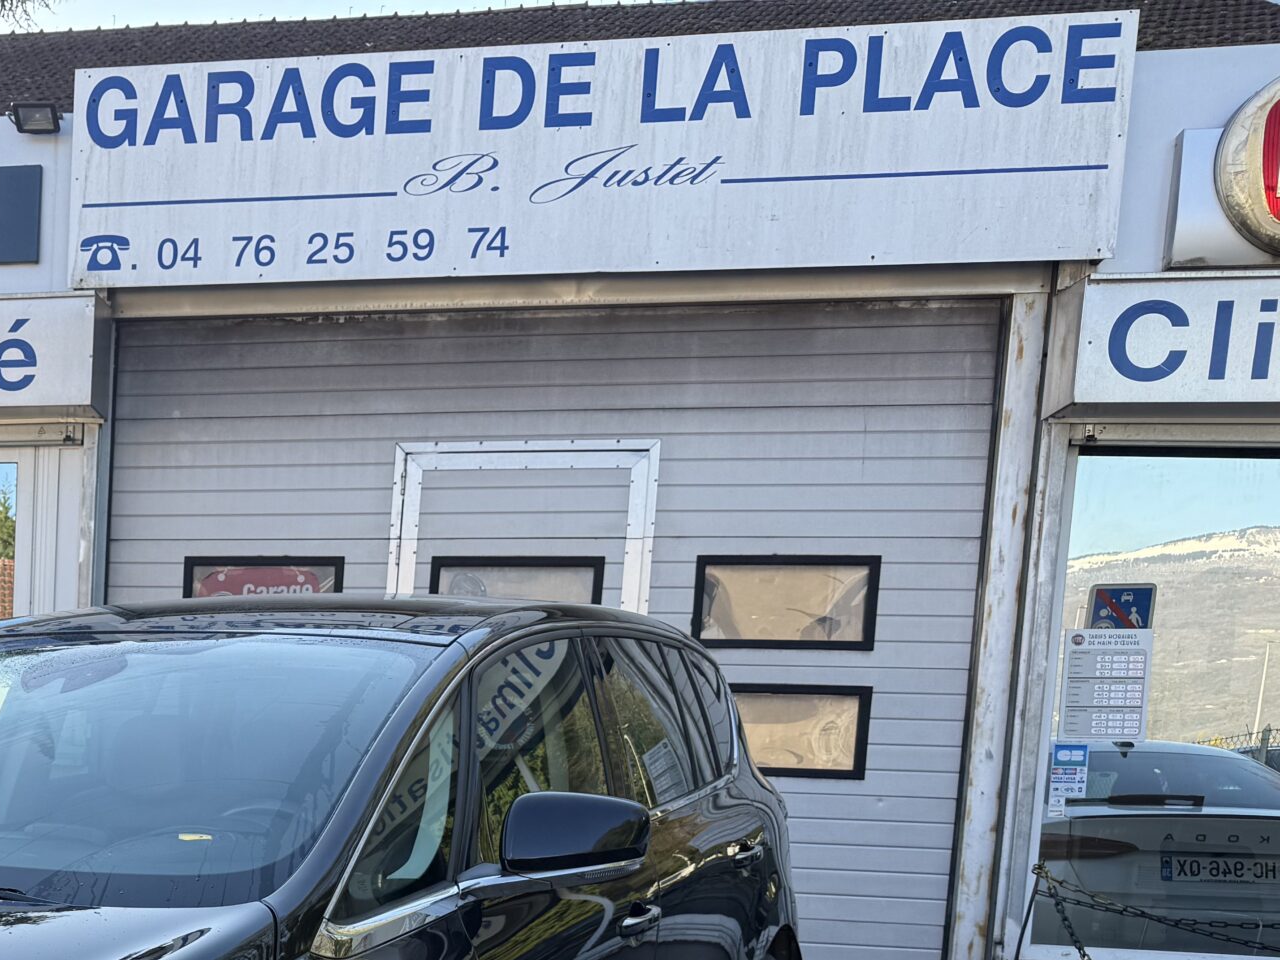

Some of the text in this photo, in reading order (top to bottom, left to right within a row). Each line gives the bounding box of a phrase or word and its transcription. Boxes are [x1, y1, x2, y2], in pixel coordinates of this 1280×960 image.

[86, 22, 1122, 149] GARAGE DE LA PLACE
[403, 144, 726, 204] B. Justet
[157, 226, 510, 270] 04 76 25 59 74
